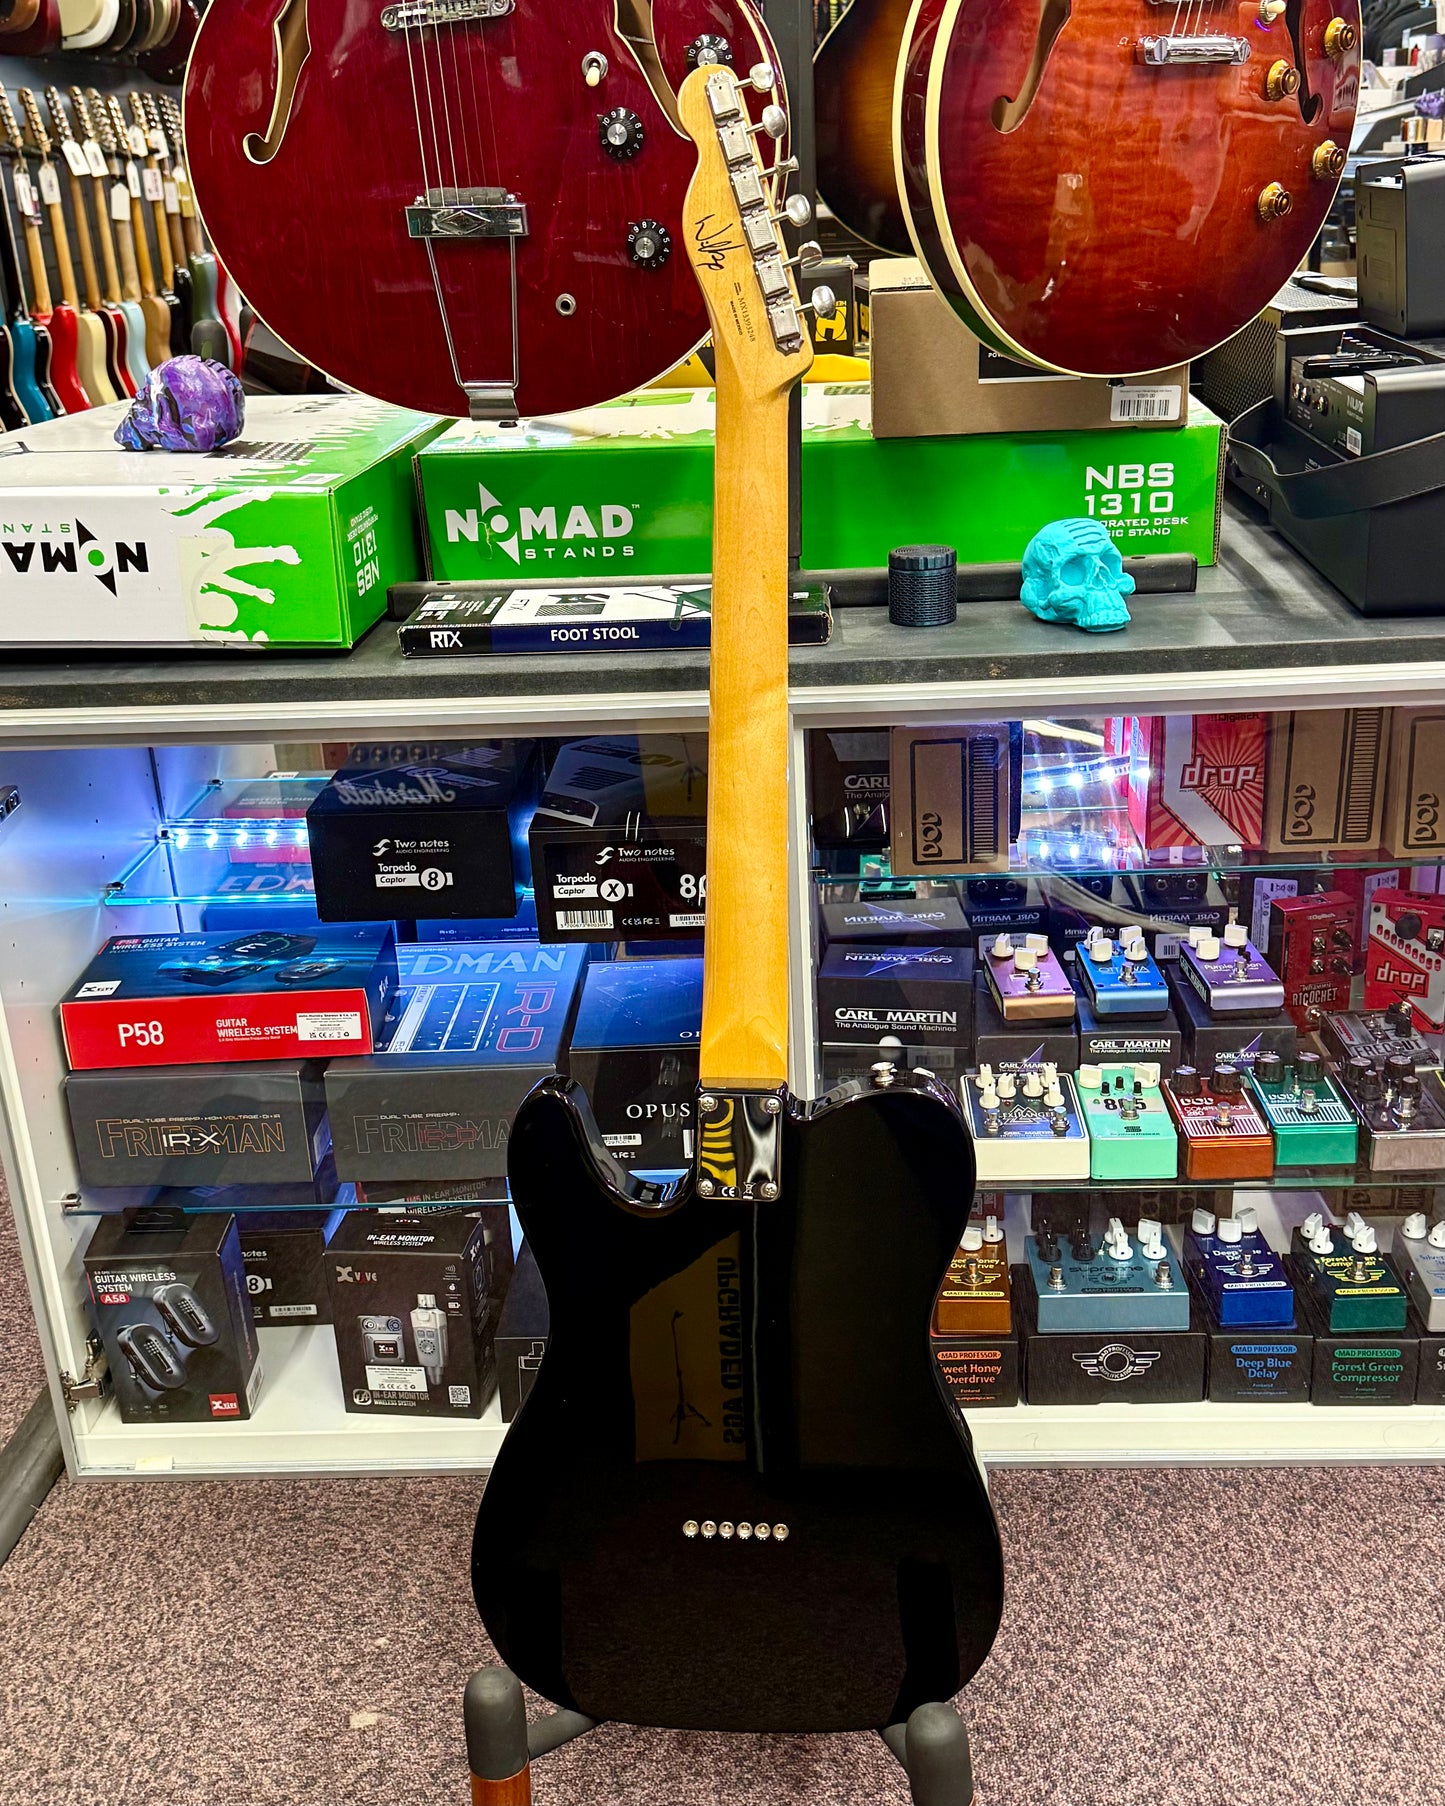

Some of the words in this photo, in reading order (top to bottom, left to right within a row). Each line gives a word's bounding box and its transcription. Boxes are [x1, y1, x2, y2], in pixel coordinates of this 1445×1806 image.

[1085, 463, 1175, 491] NBS
[1084, 491, 1174, 516] 1310
[3, 523, 71, 534] STAN
[445, 505, 633, 542] NOMAD
[1100, 519, 1150, 528] ORATED
[1154, 517, 1189, 525] DESK
[1107, 529, 1124, 538] SIC
[1128, 528, 1171, 537] STAND
[353, 530, 377, 566] 1310
[525, 545, 634, 560] STANDS
[1, 541, 150, 573] NOMA
[357, 556, 380, 597] NBS
[430, 631, 463, 648] RTX
[551, 629, 589, 642] FOOT
[593, 627, 640, 640] STOOL
[1182, 755, 1258, 792] drop
[844, 775, 889, 789] CARL
[864, 791, 889, 799] Analo
[394, 840, 416, 848] Two
[420, 839, 449, 848] notes
[618, 848, 641, 857] Two
[644, 847, 675, 856] notes
[378, 862, 417, 873] Torpedo
[380, 876, 407, 884] Captor
[428, 872, 438, 888] 8
[556, 873, 597, 885] Torpedo
[558, 887, 586, 895] Captor
[607, 883, 620, 898] X
[112, 942, 164, 950] WIRELESS
[166, 940, 206, 948] SYSTEM
[399, 951, 566, 976] EDMAN
[1376, 961, 1427, 989] drop
[1292, 988, 1338, 1006] RICOCHET
[496, 982, 557, 1053] IR-D
[835, 1008, 878, 1020] CARL
[886, 1011, 957, 1024] MARTIN
[216, 1018, 248, 1028] GUITAR
[852, 1022, 889, 1031] Analogue
[891, 1023, 917, 1031] Sound
[919, 1024, 957, 1032] Machines
[118, 1021, 164, 1048] P58
[217, 1027, 262, 1038] WIRELESS
[264, 1025, 299, 1035] SYSTEM
[1089, 1039, 1118, 1048] CARL
[1124, 1039, 1171, 1048] MARTIN
[626, 1103, 691, 1119] OPUS
[162, 1132, 222, 1148] IR-X
[353, 1115, 511, 1154] FRIEDMA
[422, 1189, 450, 1201] IN-EAR
[452, 1181, 487, 1194] MONITOR
[397, 1235, 435, 1243] MONITOR
[95, 1275, 129, 1284] GUITAR
[129, 1272, 177, 1282] WIRELESS
[97, 1283, 133, 1293] SYSTEM
[249, 1278, 259, 1292] 8
[104, 1294, 127, 1303] A58
[941, 1351, 959, 1359] MAD
[959, 1351, 998, 1359] PROFESSOR
[1338, 1349, 1355, 1357] MAD
[941, 1364, 968, 1374] weet
[969, 1364, 1002, 1375] Honey
[1236, 1358, 1264, 1369] Deep
[1267, 1358, 1292, 1368] Blue
[1331, 1362, 1367, 1372] Forest
[1369, 1362, 1404, 1372] Green
[946, 1375, 996, 1384] Overdrive
[1248, 1369, 1279, 1380] Delay
[1333, 1373, 1400, 1384] Compressor
[373, 1391, 397, 1399] IN-EAR
[398, 1391, 430, 1401] MONITOR
